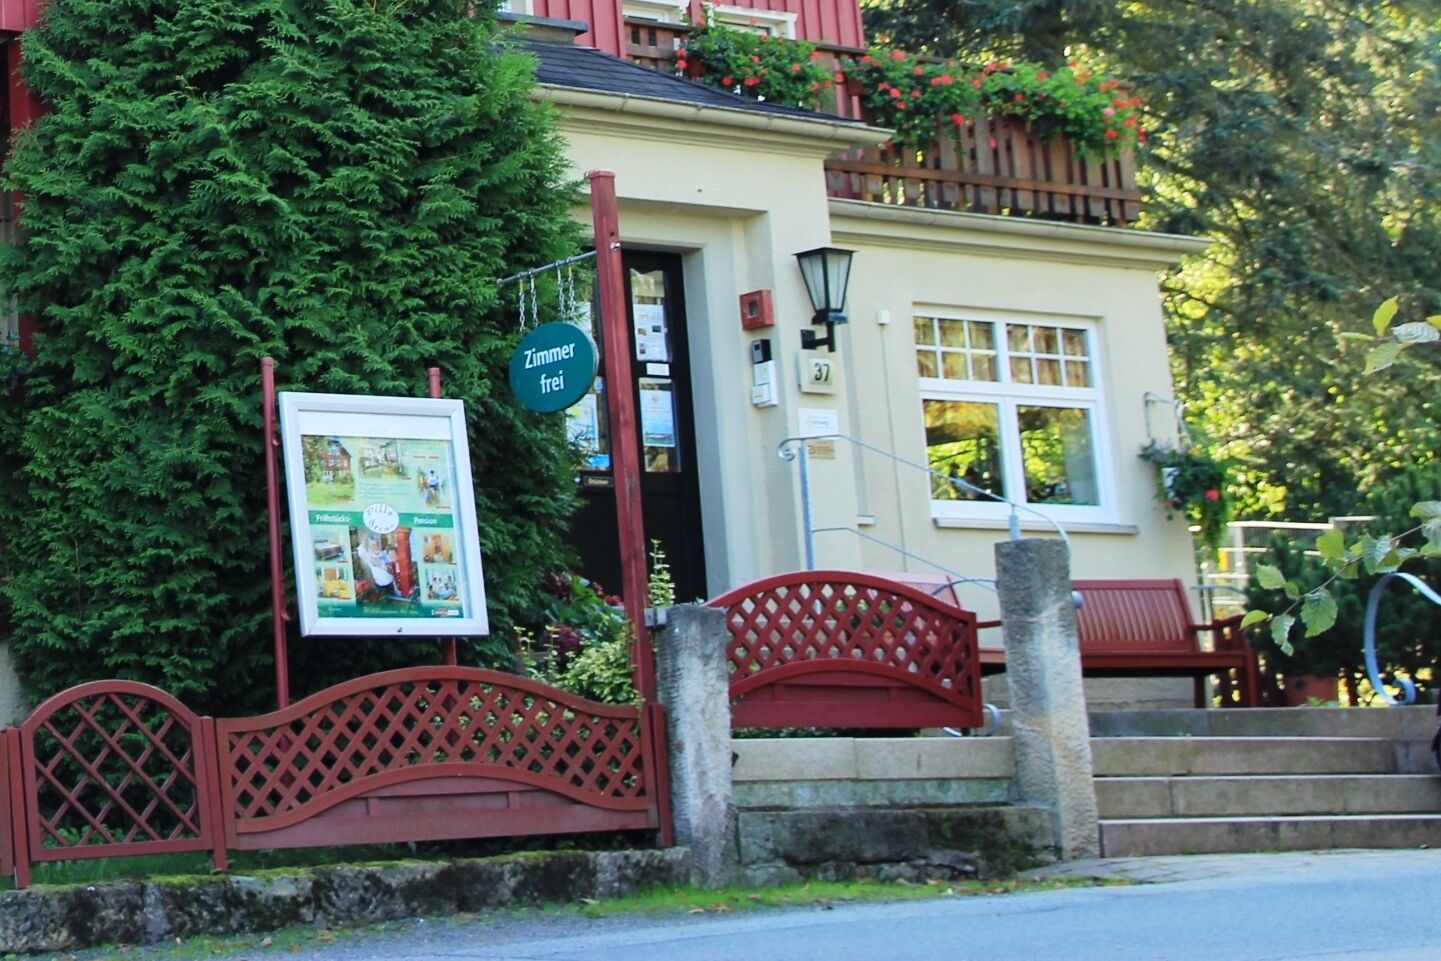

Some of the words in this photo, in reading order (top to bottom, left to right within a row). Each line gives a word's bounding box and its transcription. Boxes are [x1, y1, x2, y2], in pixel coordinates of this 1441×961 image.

[523, 342, 575, 369] Zimmer
[539, 369, 565, 394] frei
[814, 362, 830, 382] 37
